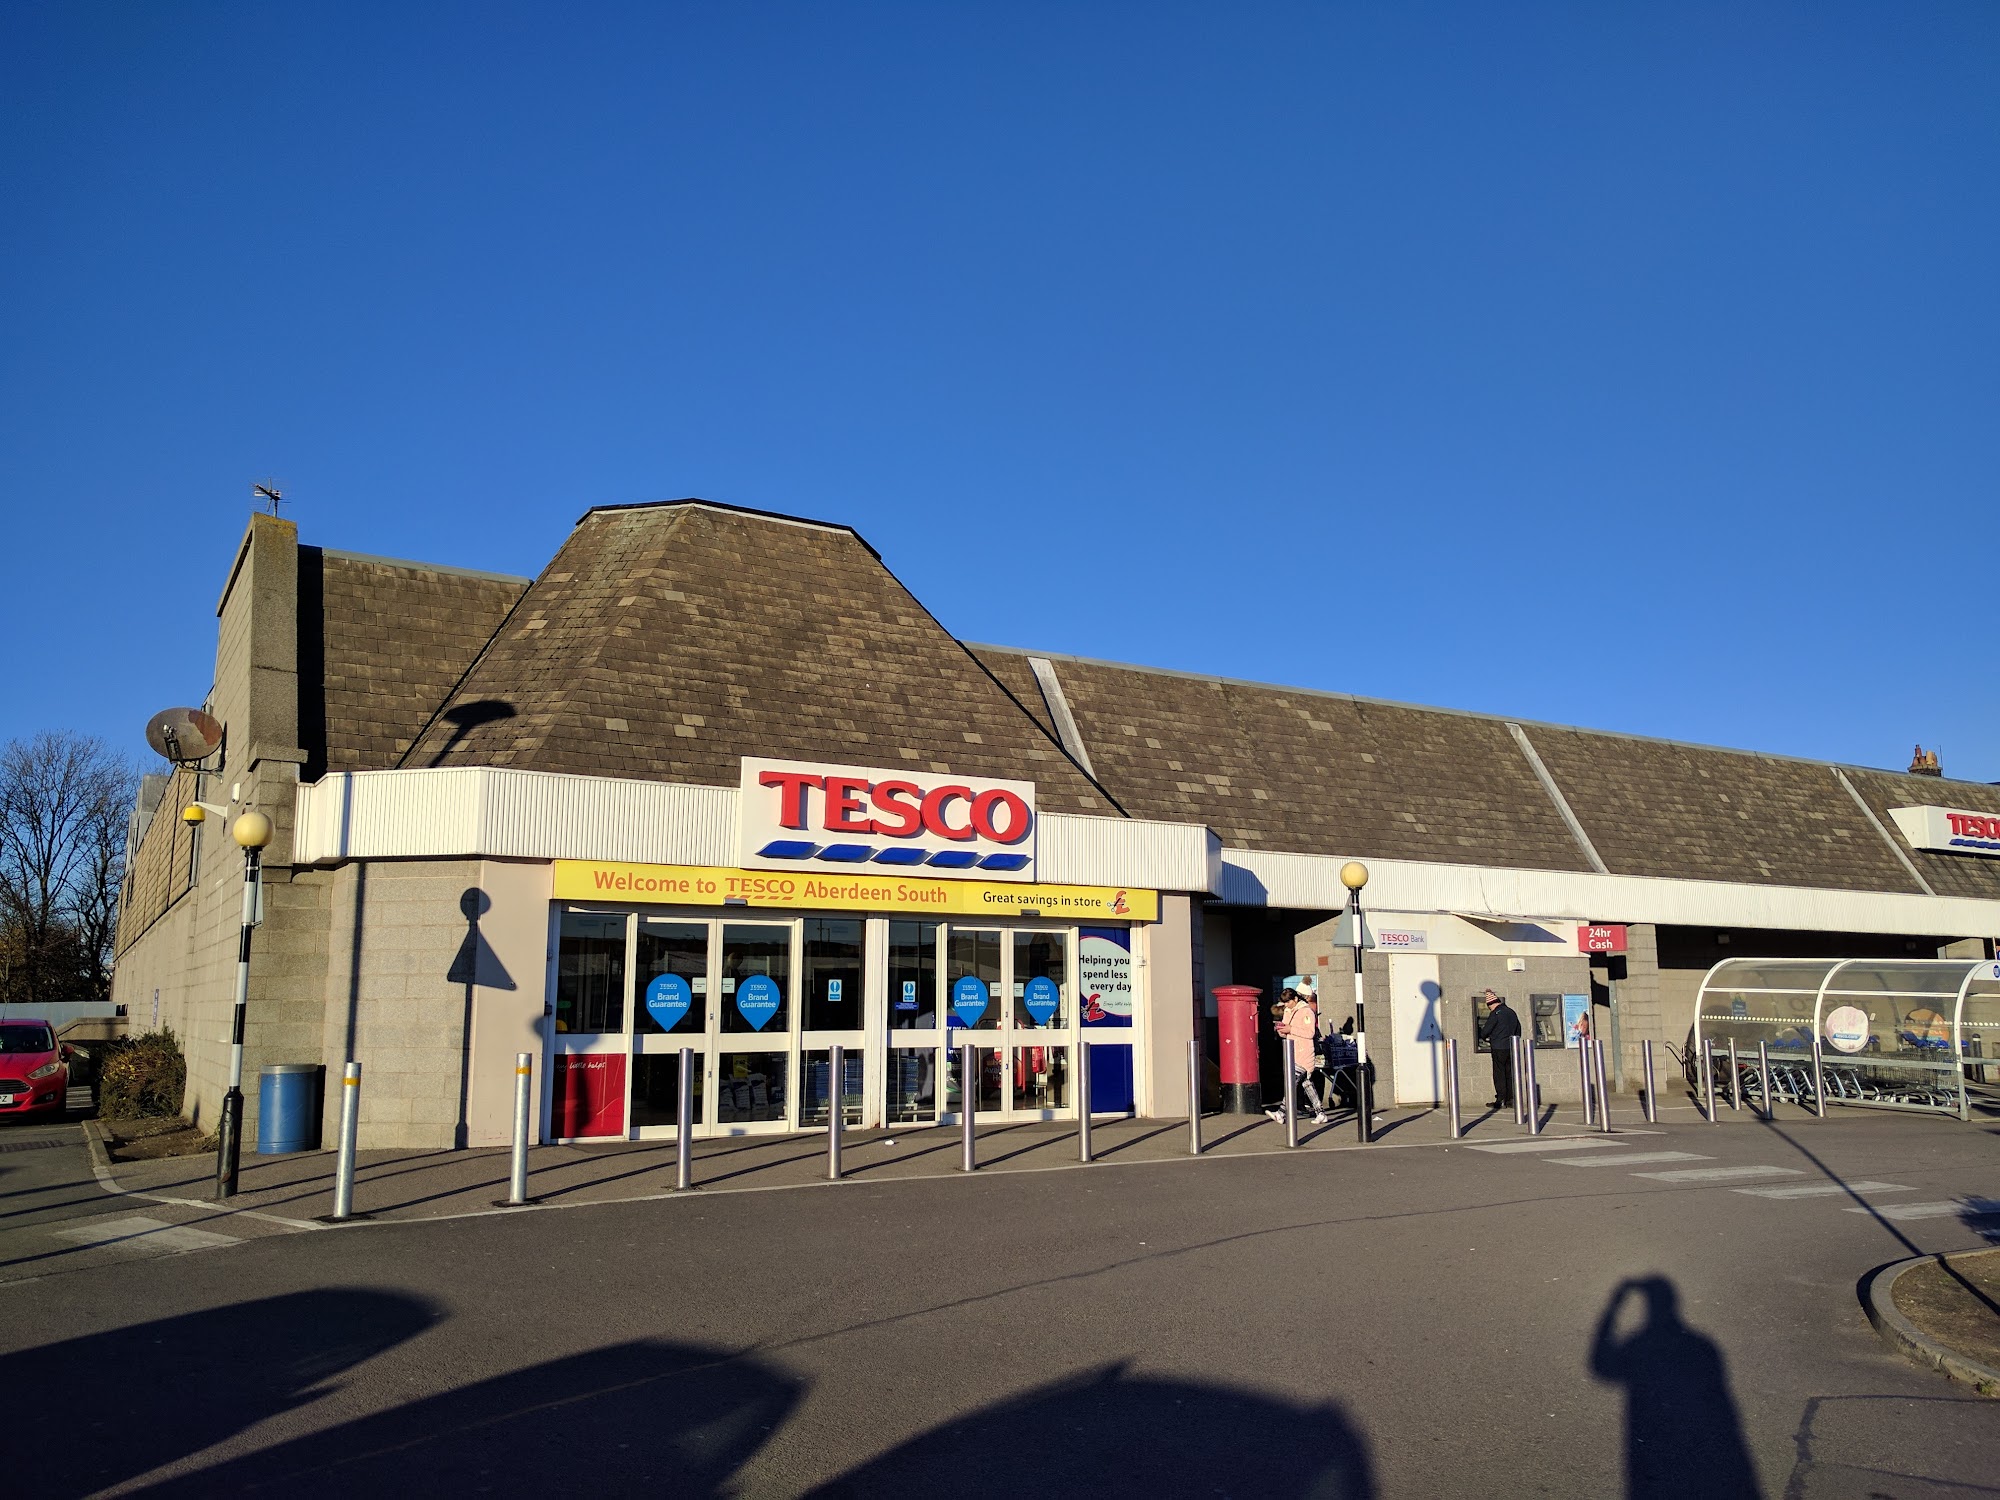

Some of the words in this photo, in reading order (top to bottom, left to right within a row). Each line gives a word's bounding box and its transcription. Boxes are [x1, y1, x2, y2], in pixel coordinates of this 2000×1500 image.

[759, 771, 1032, 845] TESCO
[1946, 813, 2000, 840] TESC
[594, 871, 689, 893] Welcome
[696, 878, 717, 894] to
[725, 878, 795, 894] TESCO
[804, 881, 891, 900] Aberdeen
[897, 885, 947, 903] South
[983, 891, 1015, 904] Great
[1017, 894, 1058, 908] savings
[1061, 895, 1071, 906] in
[1074, 897, 1102, 907] store
[1381, 933, 1409, 942] TESCO
[1410, 934, 1424, 943] Bank
[1588, 928, 1612, 938] 24hr
[1588, 939, 1613, 949] Cash
[1080, 954, 1112, 967] Helping
[1114, 958, 1130, 967] you
[1083, 969, 1109, 980] spend
[1111, 969, 1128, 979] less
[1090, 983, 1114, 993] every
[1116, 981, 1132, 993] day
[657, 992, 680, 1001] Brand
[748, 993, 769, 1001] Brand
[648, 1000, 688, 1008] Guarantee
[740, 1000, 777, 1009] Guarantee
[1027, 999, 1056, 1007] Guarantee
